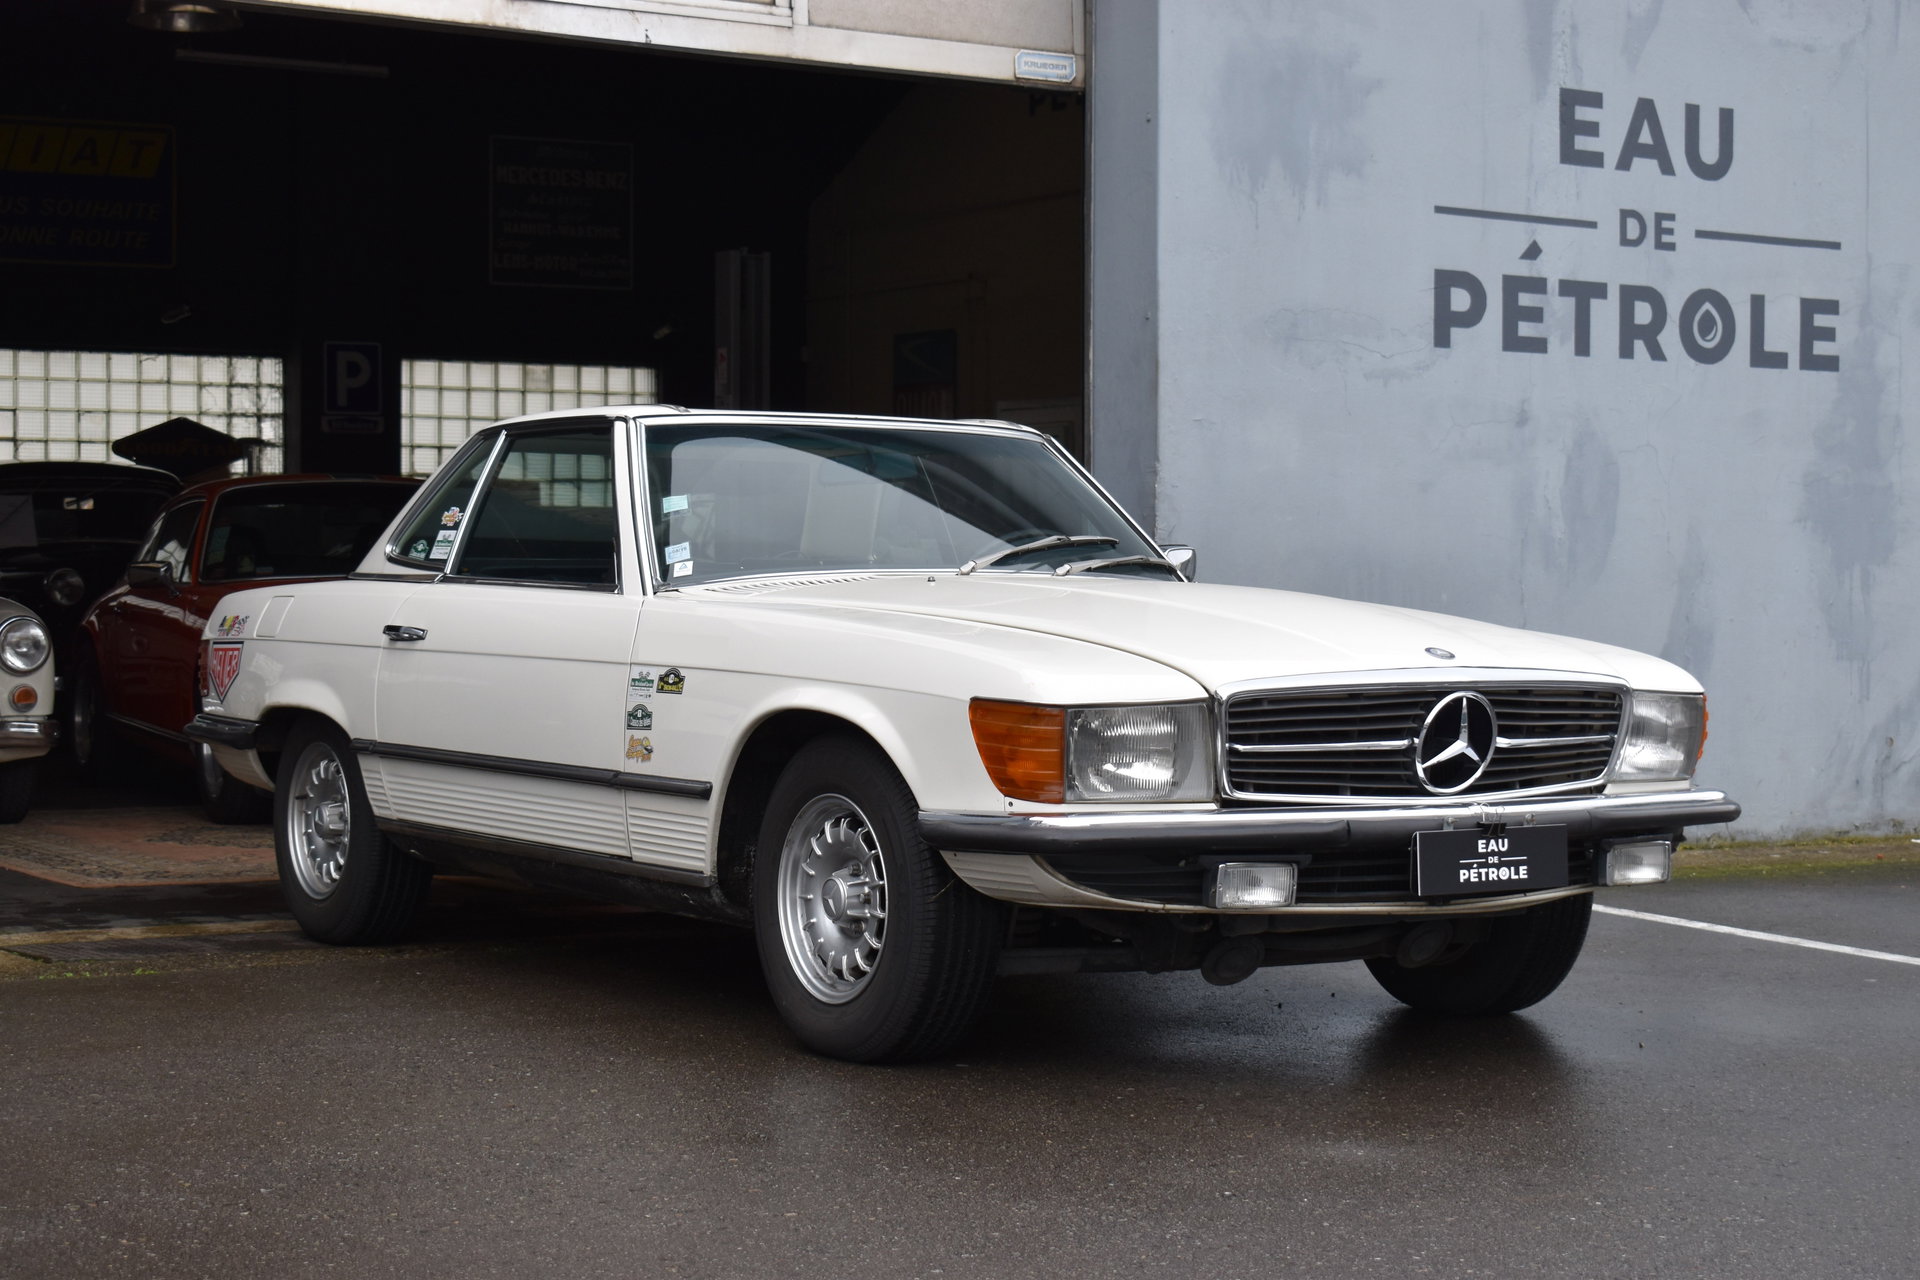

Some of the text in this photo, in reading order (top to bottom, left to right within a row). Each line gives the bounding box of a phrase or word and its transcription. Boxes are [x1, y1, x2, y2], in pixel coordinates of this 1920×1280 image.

[1024, 61, 1067, 70] KRUEGER
[29, 131, 157, 169] IAT
[1558, 86, 1735, 182] EAU
[495, 164, 628, 192] MERCEDES-BENZ
[0, 195, 161, 222] US SOUHAITE
[0, 226, 152, 249] ONNE ROUTE
[1618, 208, 1677, 252] DE
[1433, 238, 1841, 373] PÉTROLE
[335, 350, 372, 408] P
[211, 650, 240, 690] HEUER
[1478, 839, 1508, 852] EAU
[1459, 864, 1528, 882] PÉTROLE
